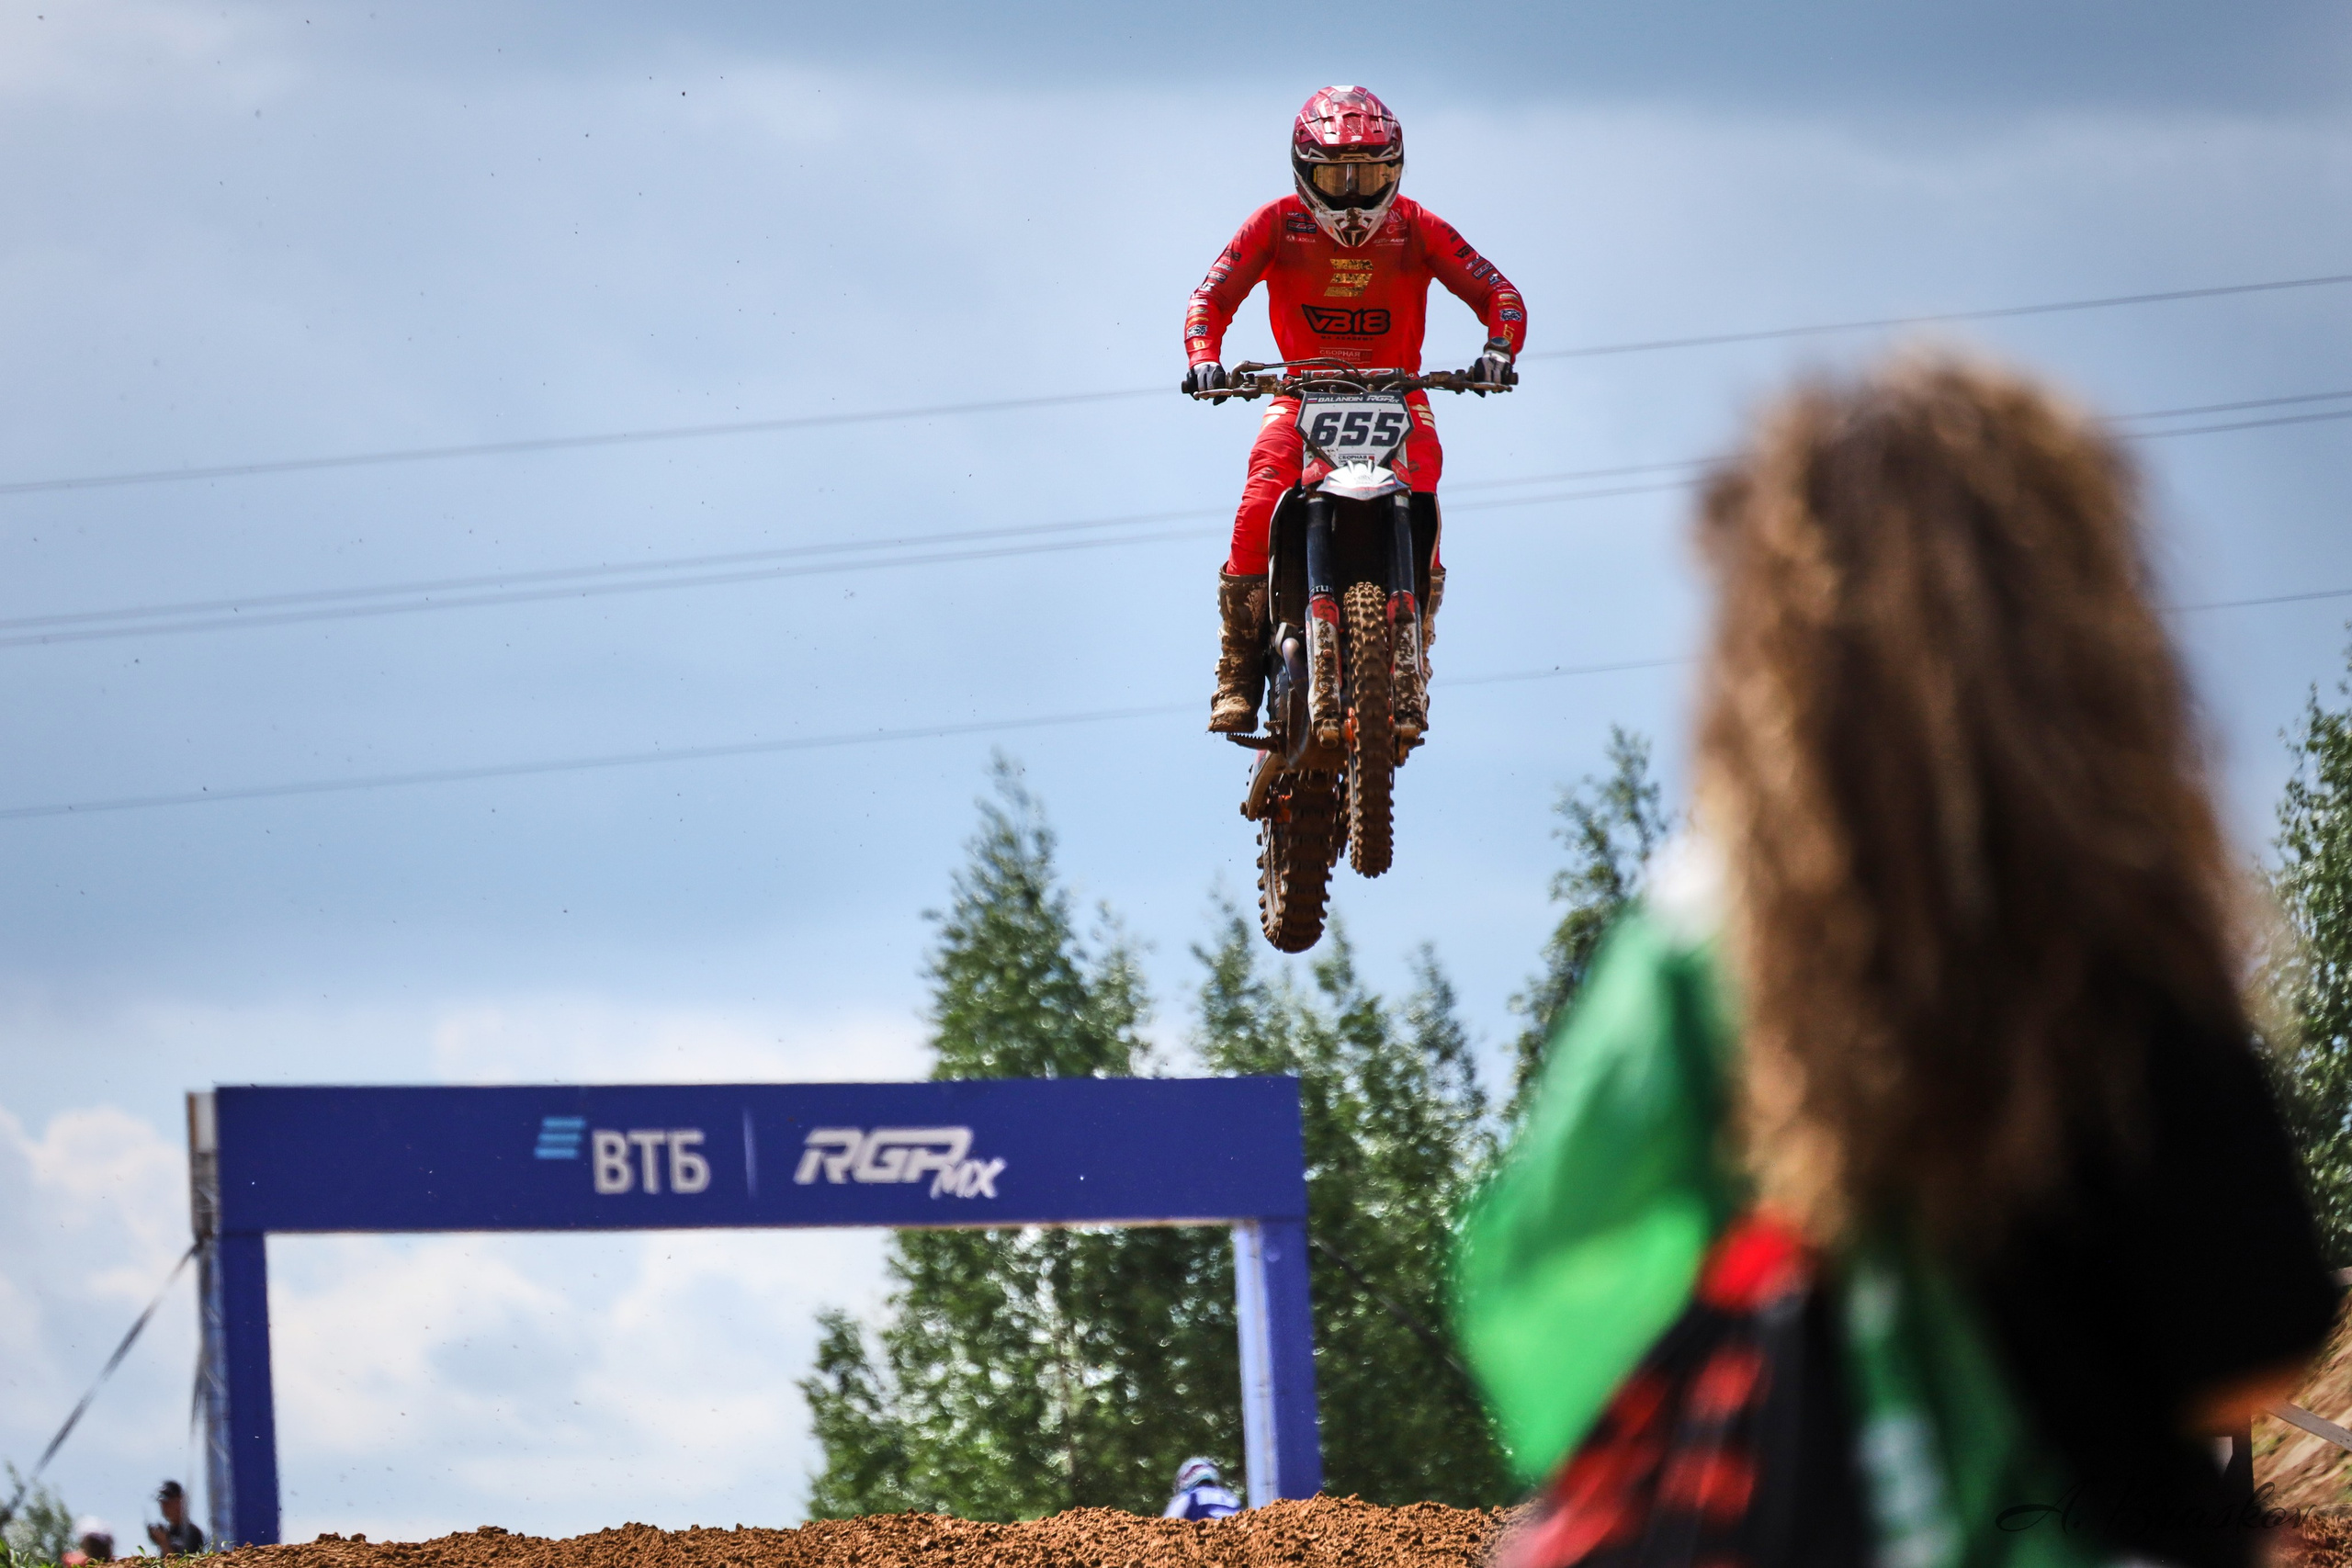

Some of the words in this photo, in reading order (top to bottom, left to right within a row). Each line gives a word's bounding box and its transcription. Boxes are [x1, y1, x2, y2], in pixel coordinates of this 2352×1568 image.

[1301, 304, 1391, 335] VB18
[1319, 349, 1361, 357] СБОРНАЯ
[1310, 412, 1406, 446] 655
[592, 1128, 711, 1194] ВТБ
